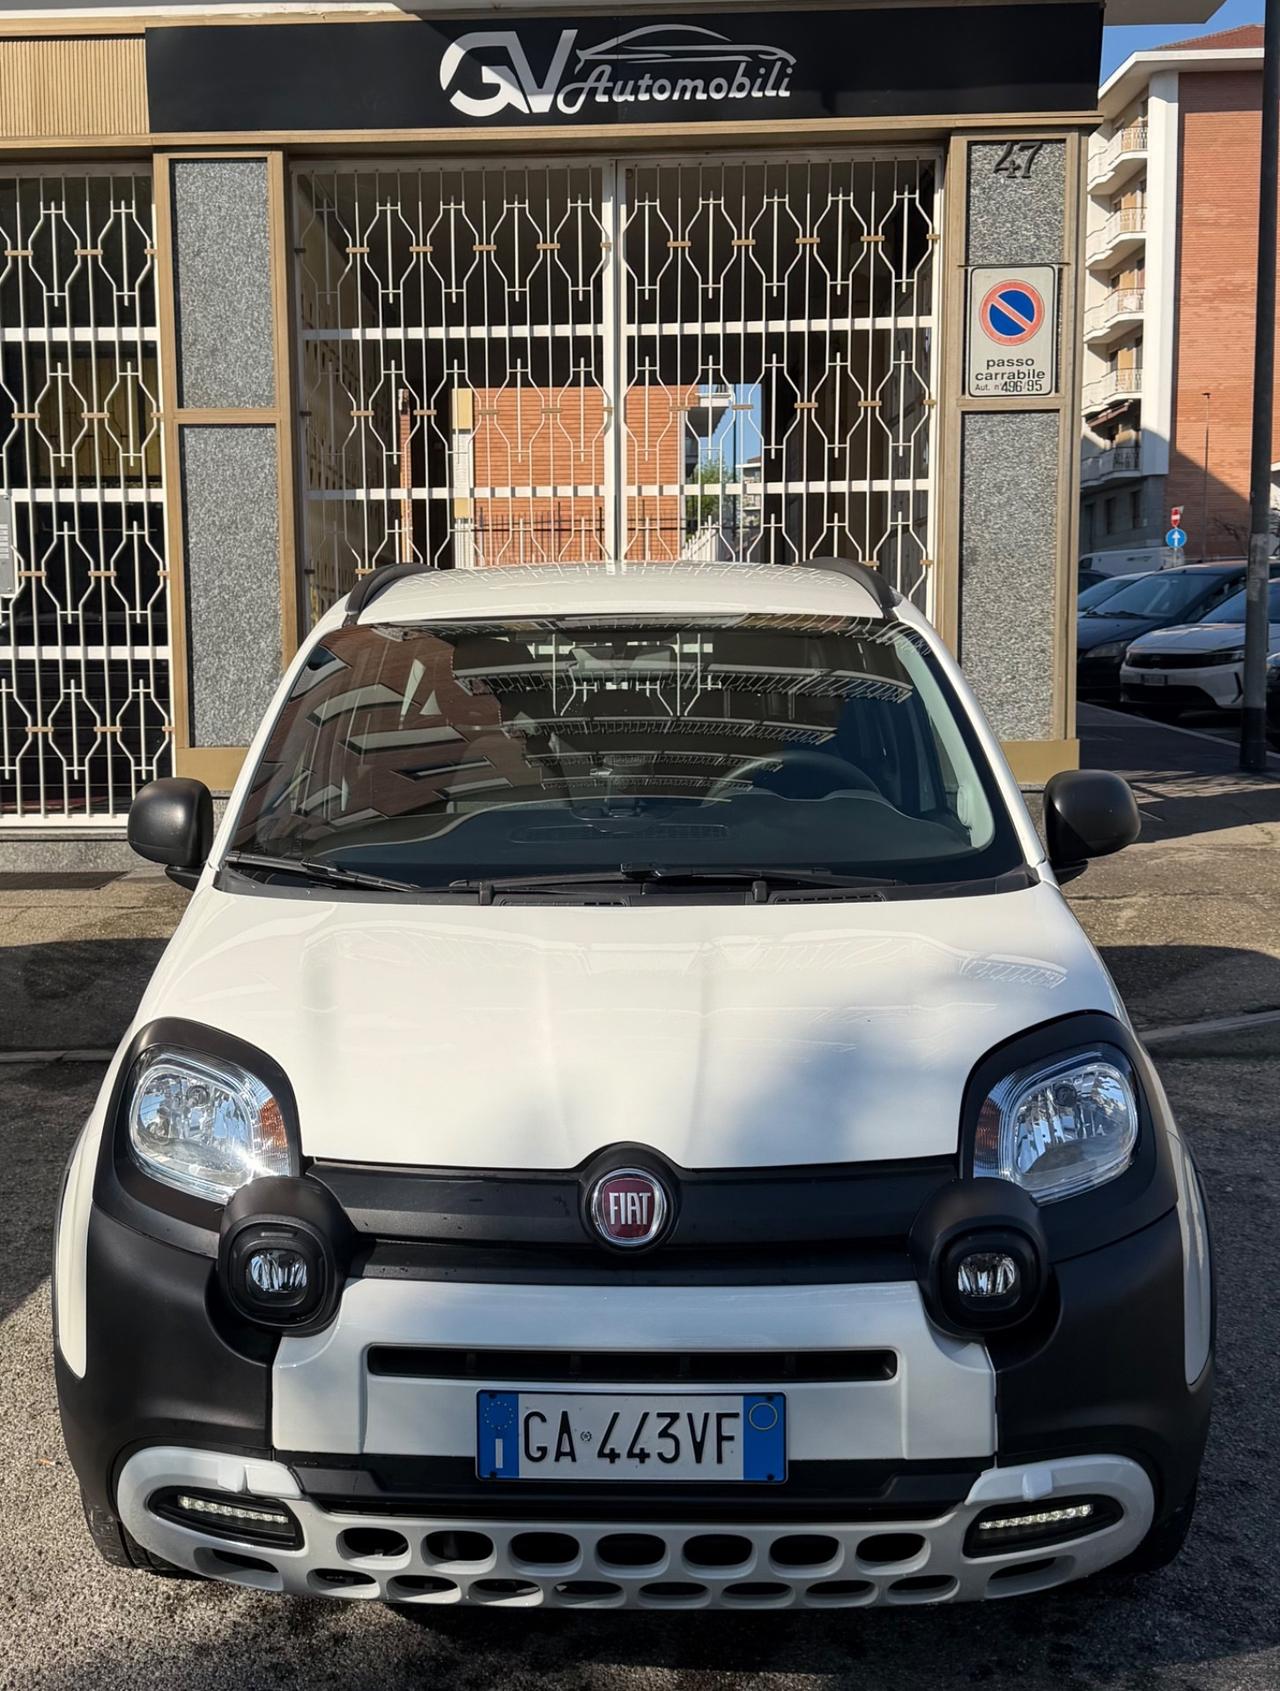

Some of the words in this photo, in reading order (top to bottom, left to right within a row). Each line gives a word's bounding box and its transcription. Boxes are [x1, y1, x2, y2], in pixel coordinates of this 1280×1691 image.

[556, 60, 793, 114] Automobili
[993, 141, 1043, 178] 47
[976, 370, 1045, 381] carrabile
[987, 358, 1034, 370] passo
[608, 1192, 651, 1225] FIAT
[523, 1410, 577, 1463] GA
[597, 1411, 740, 1464] 443VF
